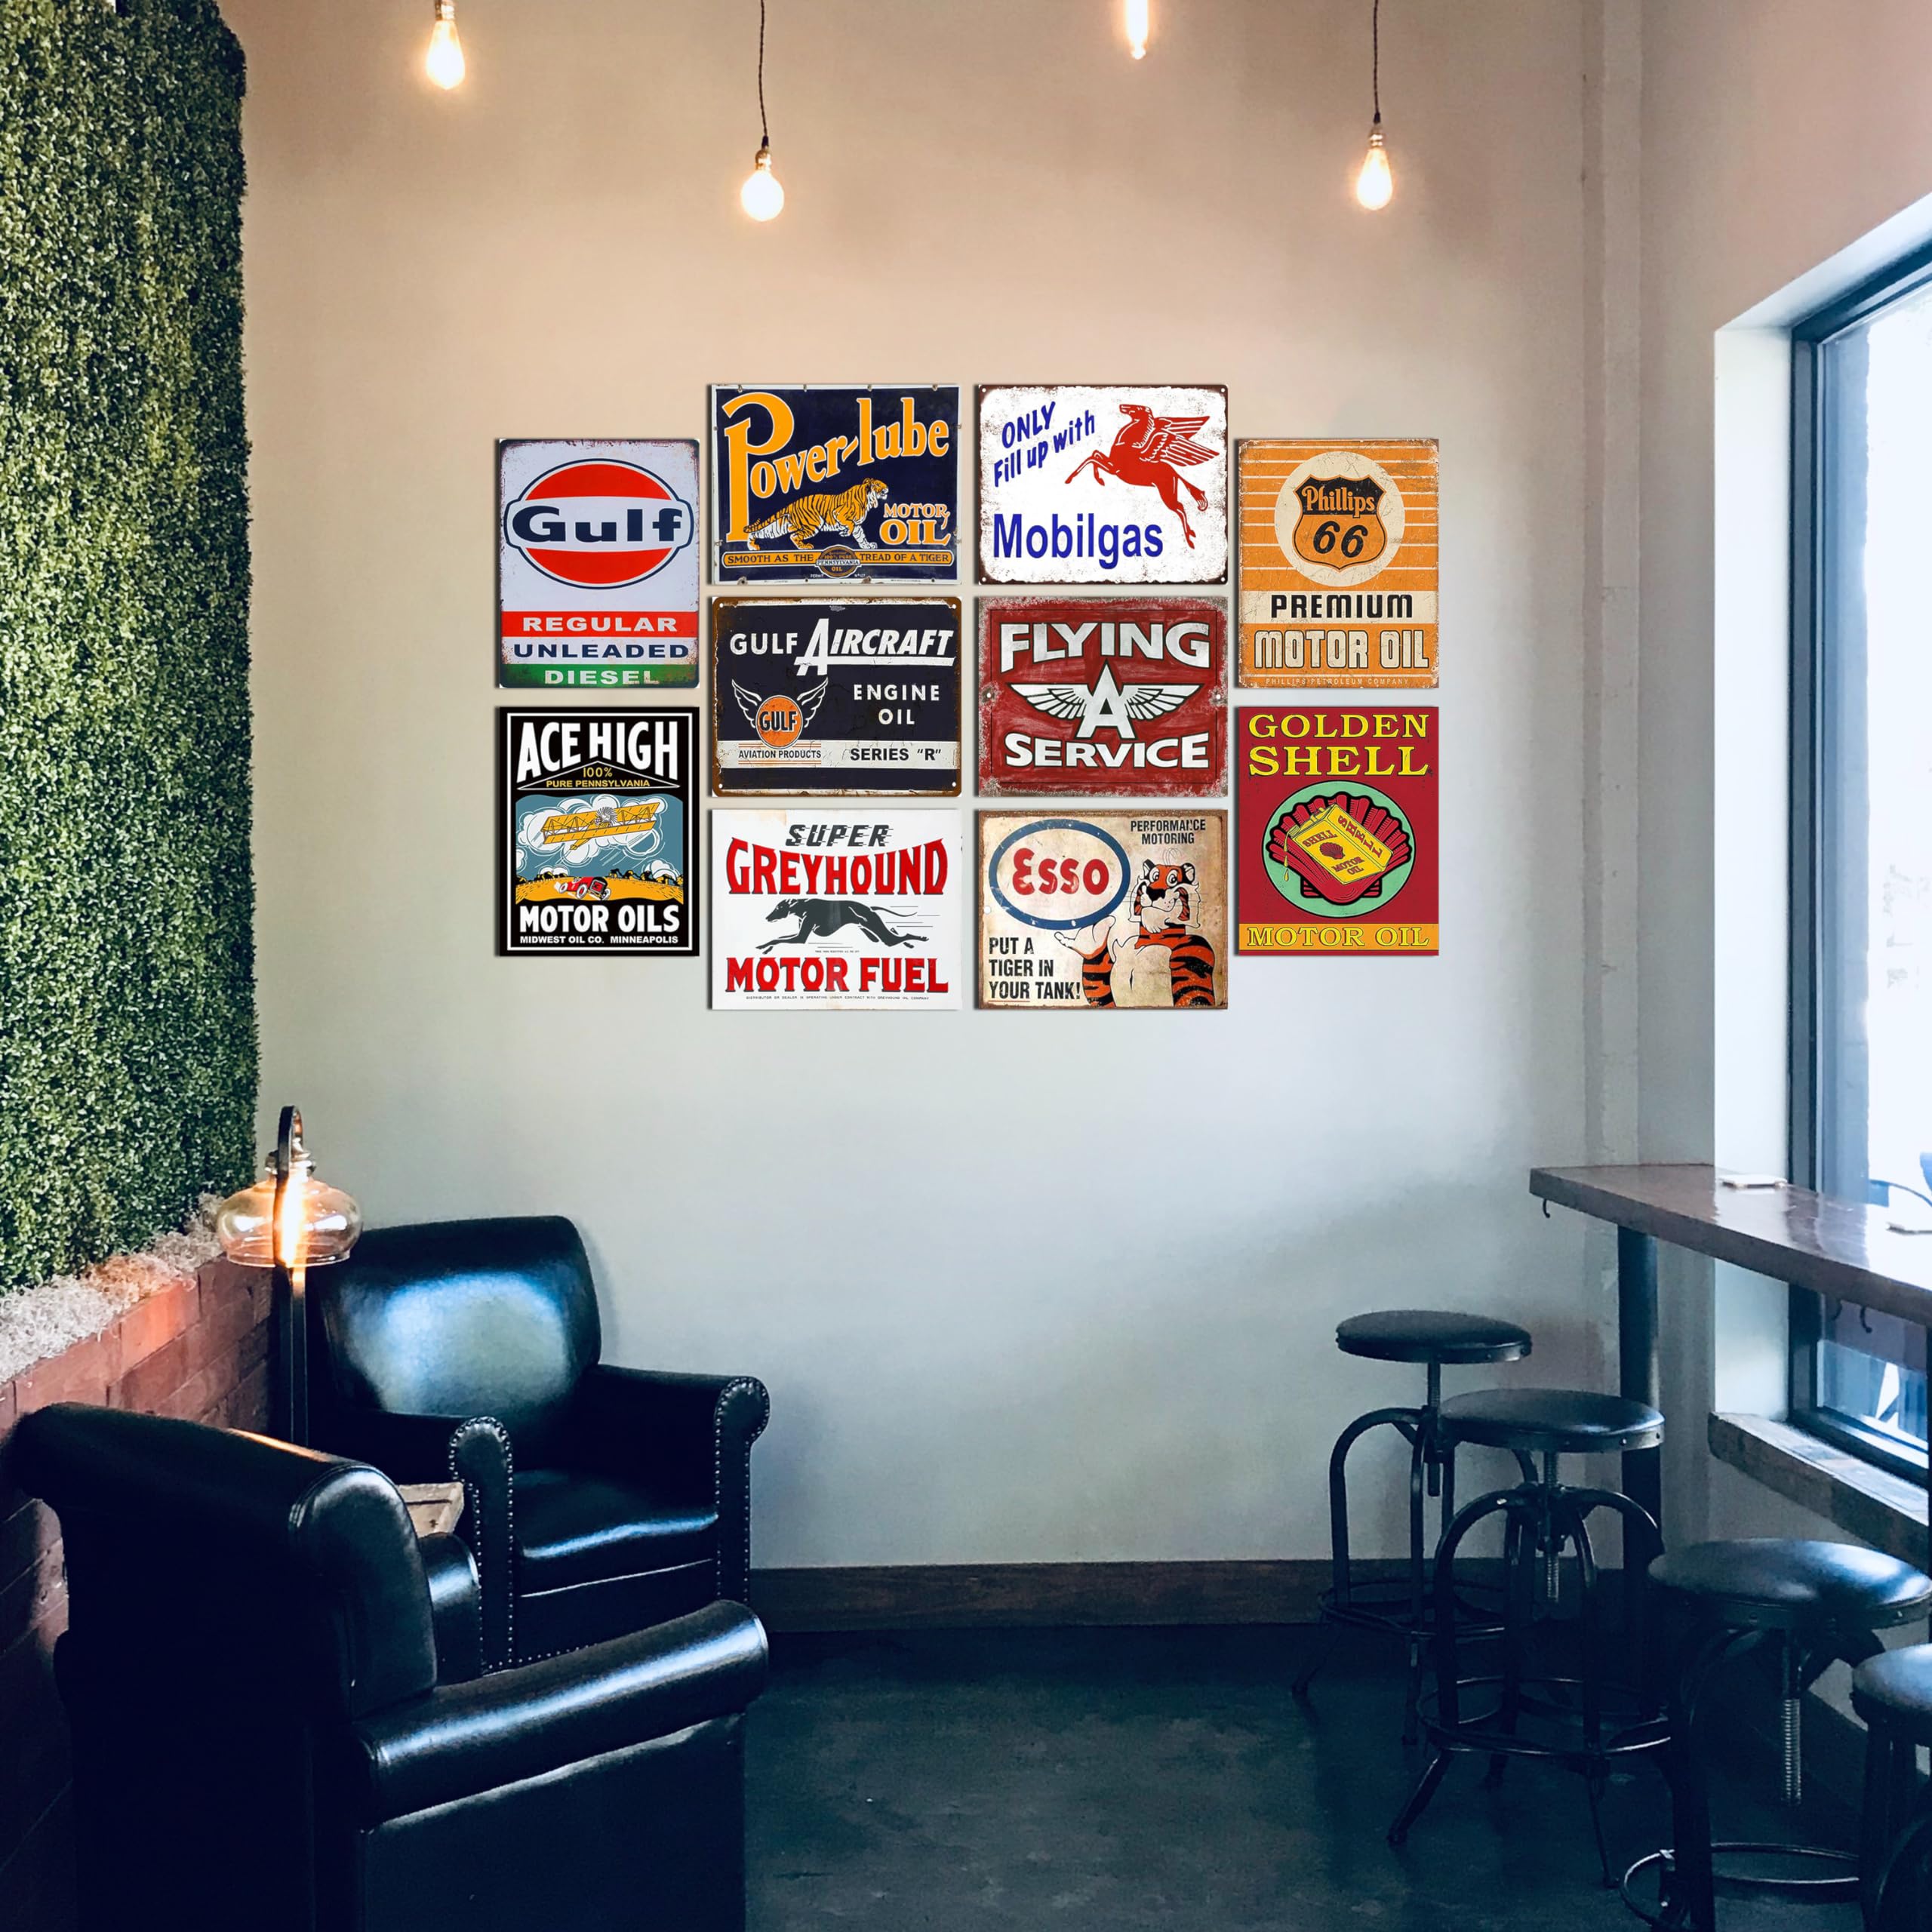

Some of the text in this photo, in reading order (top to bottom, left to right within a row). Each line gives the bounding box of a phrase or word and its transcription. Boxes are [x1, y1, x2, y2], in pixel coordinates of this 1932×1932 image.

[1001, 401, 1056, 448] ONLY
[994, 410, 1095, 488] Fill up with
[1302, 485, 1376, 518] Phillips
[512, 506, 683, 543] Gulf
[883, 503, 950, 529] MOTOR
[879, 519, 951, 545] OIL
[993, 513, 1164, 570] Mobilgas
[1313, 520, 1368, 558] 66
[727, 552, 949, 564] SMOOTH AS THE TREAD OF A TIGER
[1271, 595, 1413, 618] PREMIUM
[522, 617, 678, 632] REGULAR
[513, 644, 689, 659] UNLEADED
[730, 618, 955, 676] GULF AIRCRAFT
[999, 622, 1211, 673] FLYING
[1254, 629, 1429, 669] MOTOR OIL
[544, 670, 660, 685] DIESEL
[854, 684, 940, 701] ENGINE
[1075, 659, 1137, 739] A
[758, 711, 798, 732] GULF
[878, 709, 915, 724] OIL
[1248, 714, 1430, 738] GOLDEN
[516, 721, 678, 783] ACE HIGH
[738, 749, 821, 759] AVIATION PRODUCTS
[850, 748, 909, 761] SERIES
[1004, 731, 1210, 768] SERVICE
[583, 768, 613, 777] 100%
[1248, 746, 1429, 777] SHELL
[575, 780, 651, 788] PENNSYLVANIA
[786, 824, 894, 847] SUPER
[1141, 832, 1195, 845] MOTORING
[1302, 829, 1337, 848] SHELL
[1337, 815, 1383, 858] SHELL
[726, 837, 948, 895] GREYHOUND
[1331, 857, 1365, 872] MOTOR
[1348, 865, 1364, 875] OIL
[520, 905, 680, 933] MOTOR OILS
[989, 937, 1035, 955] PUT A
[1247, 927, 1430, 946] MOTOR OIL
[725, 957, 949, 993] MOTOR FUEL
[989, 959, 1054, 977] TIGER IN
[989, 981, 1081, 1000] YOUR TANK!
